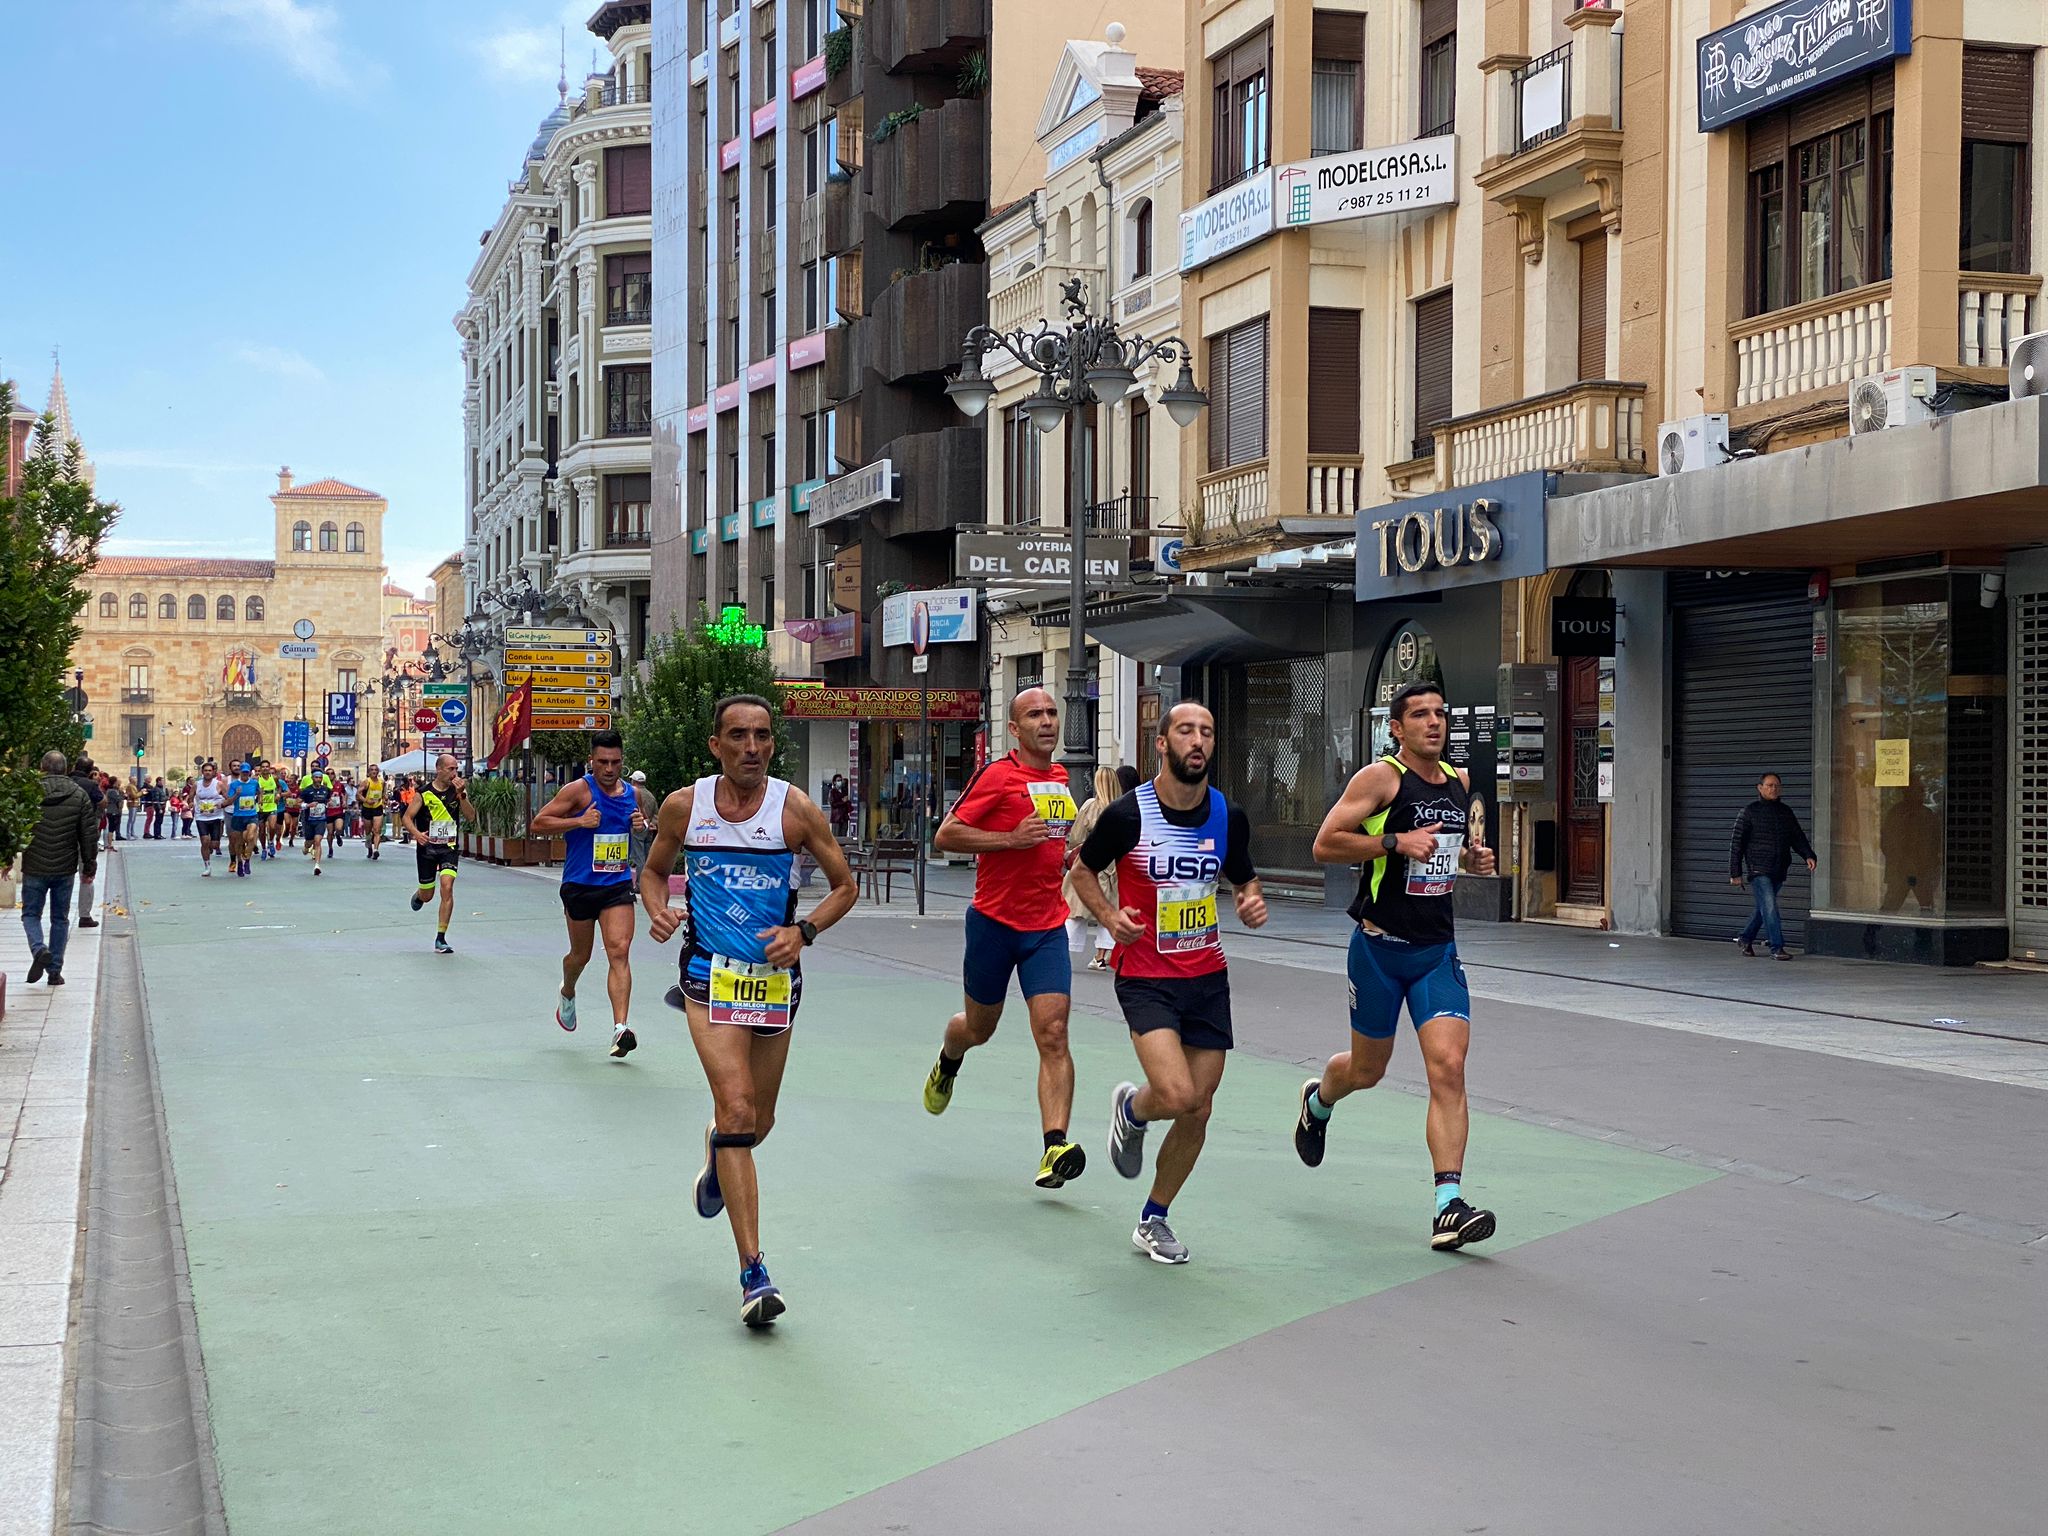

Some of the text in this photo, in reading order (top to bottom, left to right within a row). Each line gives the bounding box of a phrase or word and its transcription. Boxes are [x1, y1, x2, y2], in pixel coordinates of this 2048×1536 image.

[1350, 185, 1431, 210] 987 25 11 21
[1228, 233, 1236, 247] 25
[1236, 230, 1242, 243] 11
[1242, 228, 1250, 240] 21
[1372, 498, 1502, 578] TOUS
[1017, 541, 1072, 553] JOYERIA
[970, 555, 1119, 576] DEL CAREN
[1558, 619, 1611, 634] TOUS
[282, 644, 316, 654] Cámara
[1400, 642, 1413, 660] BE
[508, 653, 532, 661] Conde
[540, 675, 558, 683] León
[1018, 674, 1043, 687] ESTRELLA
[546, 696, 576, 704] Antonio
[785, 690, 957, 702] ROYAL TANDOORI
[1381, 684, 1394, 701] BE
[835, 702, 903, 710] RESTAURANT
[1048, 800, 1065, 819] 127
[1414, 805, 1466, 823] Xeresa
[437, 828, 449, 837] 514
[606, 847, 621, 860] 149
[720, 864, 757, 877] TRI
[1148, 855, 1221, 882] USA
[1426, 854, 1451, 875] 593
[1179, 905, 1206, 929] 103
[733, 978, 768, 1002] 106
[730, 1009, 768, 1024] Coca-Cola
